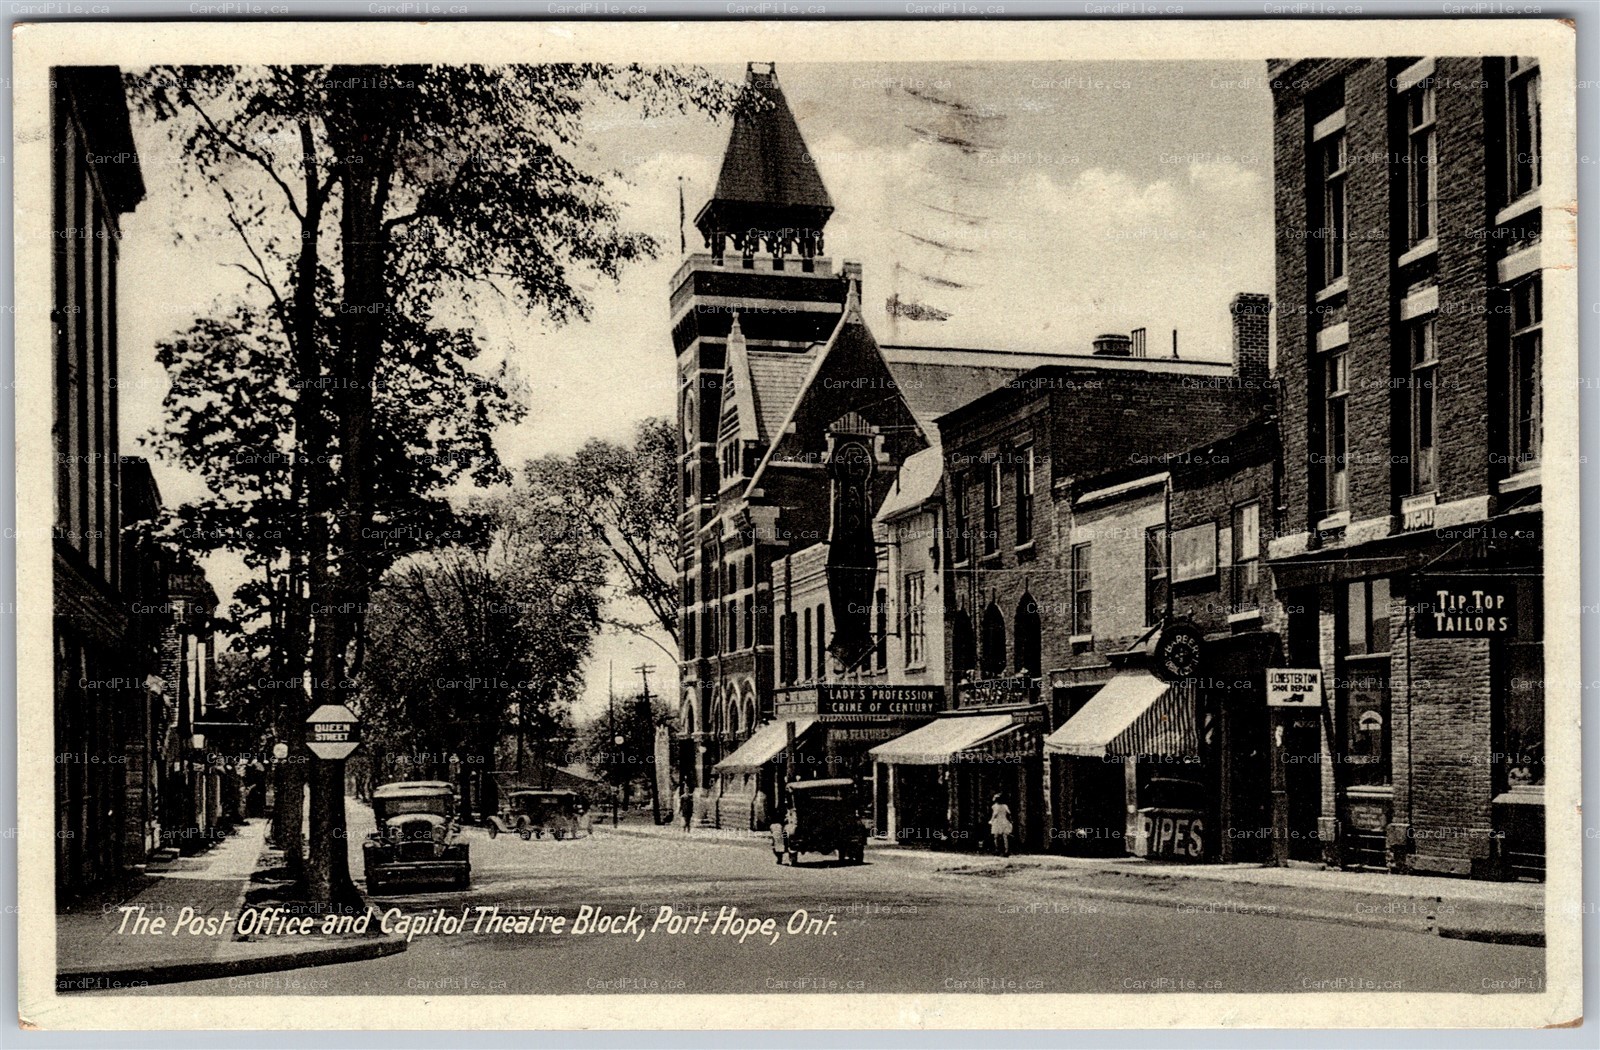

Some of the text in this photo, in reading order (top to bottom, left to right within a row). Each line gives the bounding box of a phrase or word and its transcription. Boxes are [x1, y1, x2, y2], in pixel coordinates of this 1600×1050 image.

[1433, 612, 1508, 632] TAILORS
[870, 703, 881, 712] OF
[314, 724, 350, 732] QUEEN
[315, 733, 349, 741] STREET
[1140, 816, 1204, 857] PIPES
